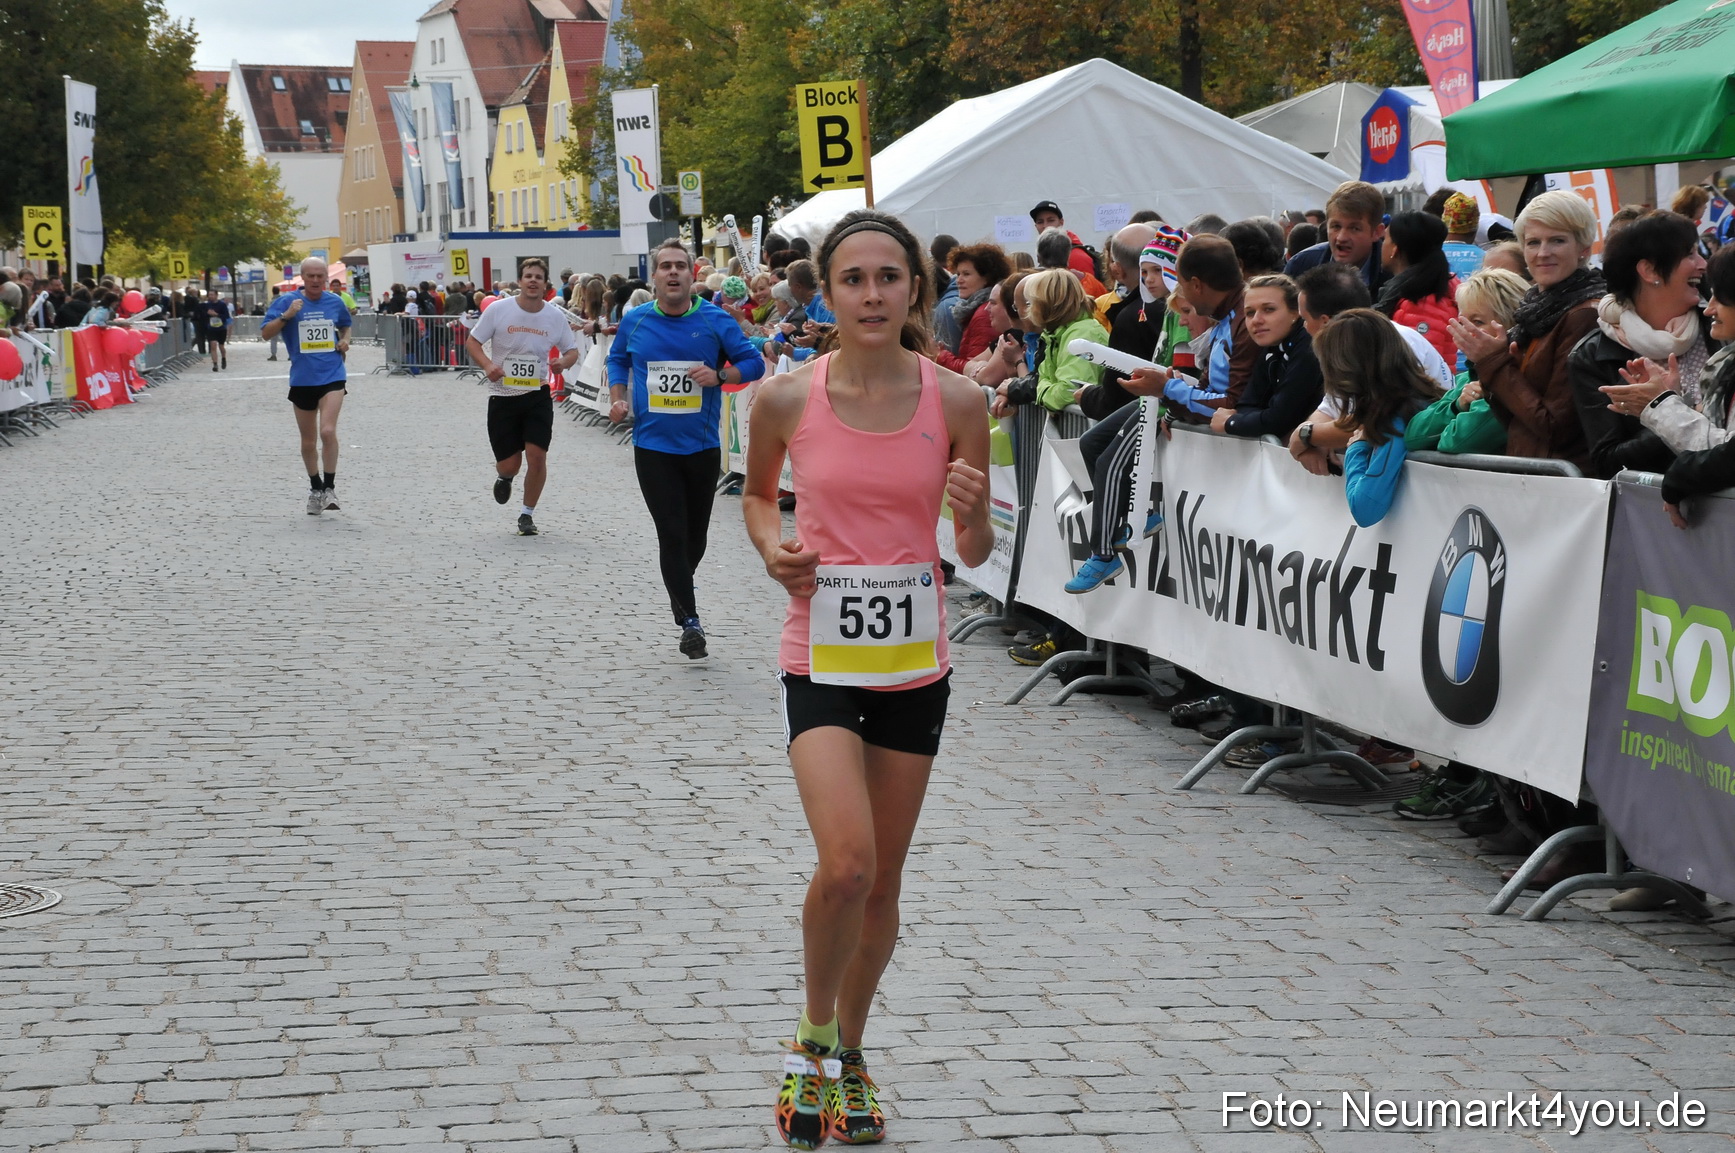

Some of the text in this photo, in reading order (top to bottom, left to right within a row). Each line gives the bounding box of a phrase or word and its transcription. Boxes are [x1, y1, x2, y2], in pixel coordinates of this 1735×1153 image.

[805, 86, 859, 107] Block
[817, 115, 853, 167] B
[1369, 119, 1397, 150] Hervis
[28, 209, 57, 219] Block
[33, 222, 53, 248] C
[174, 260, 184, 274] D
[455, 256, 465, 270] D
[307, 328, 328, 340] 320
[508, 325, 544, 336] Continental
[511, 363, 535, 377] 359
[659, 374, 693, 394] 326
[663, 398, 687, 407] Martin
[1441, 512, 1505, 587] BMW
[816, 576, 917, 589] PARTL Neumarkt
[1175, 489, 1398, 672] Neumarkt
[839, 594, 913, 640] 531
[1637, 606, 1735, 720] BO
[1620, 720, 1692, 774] inspired
